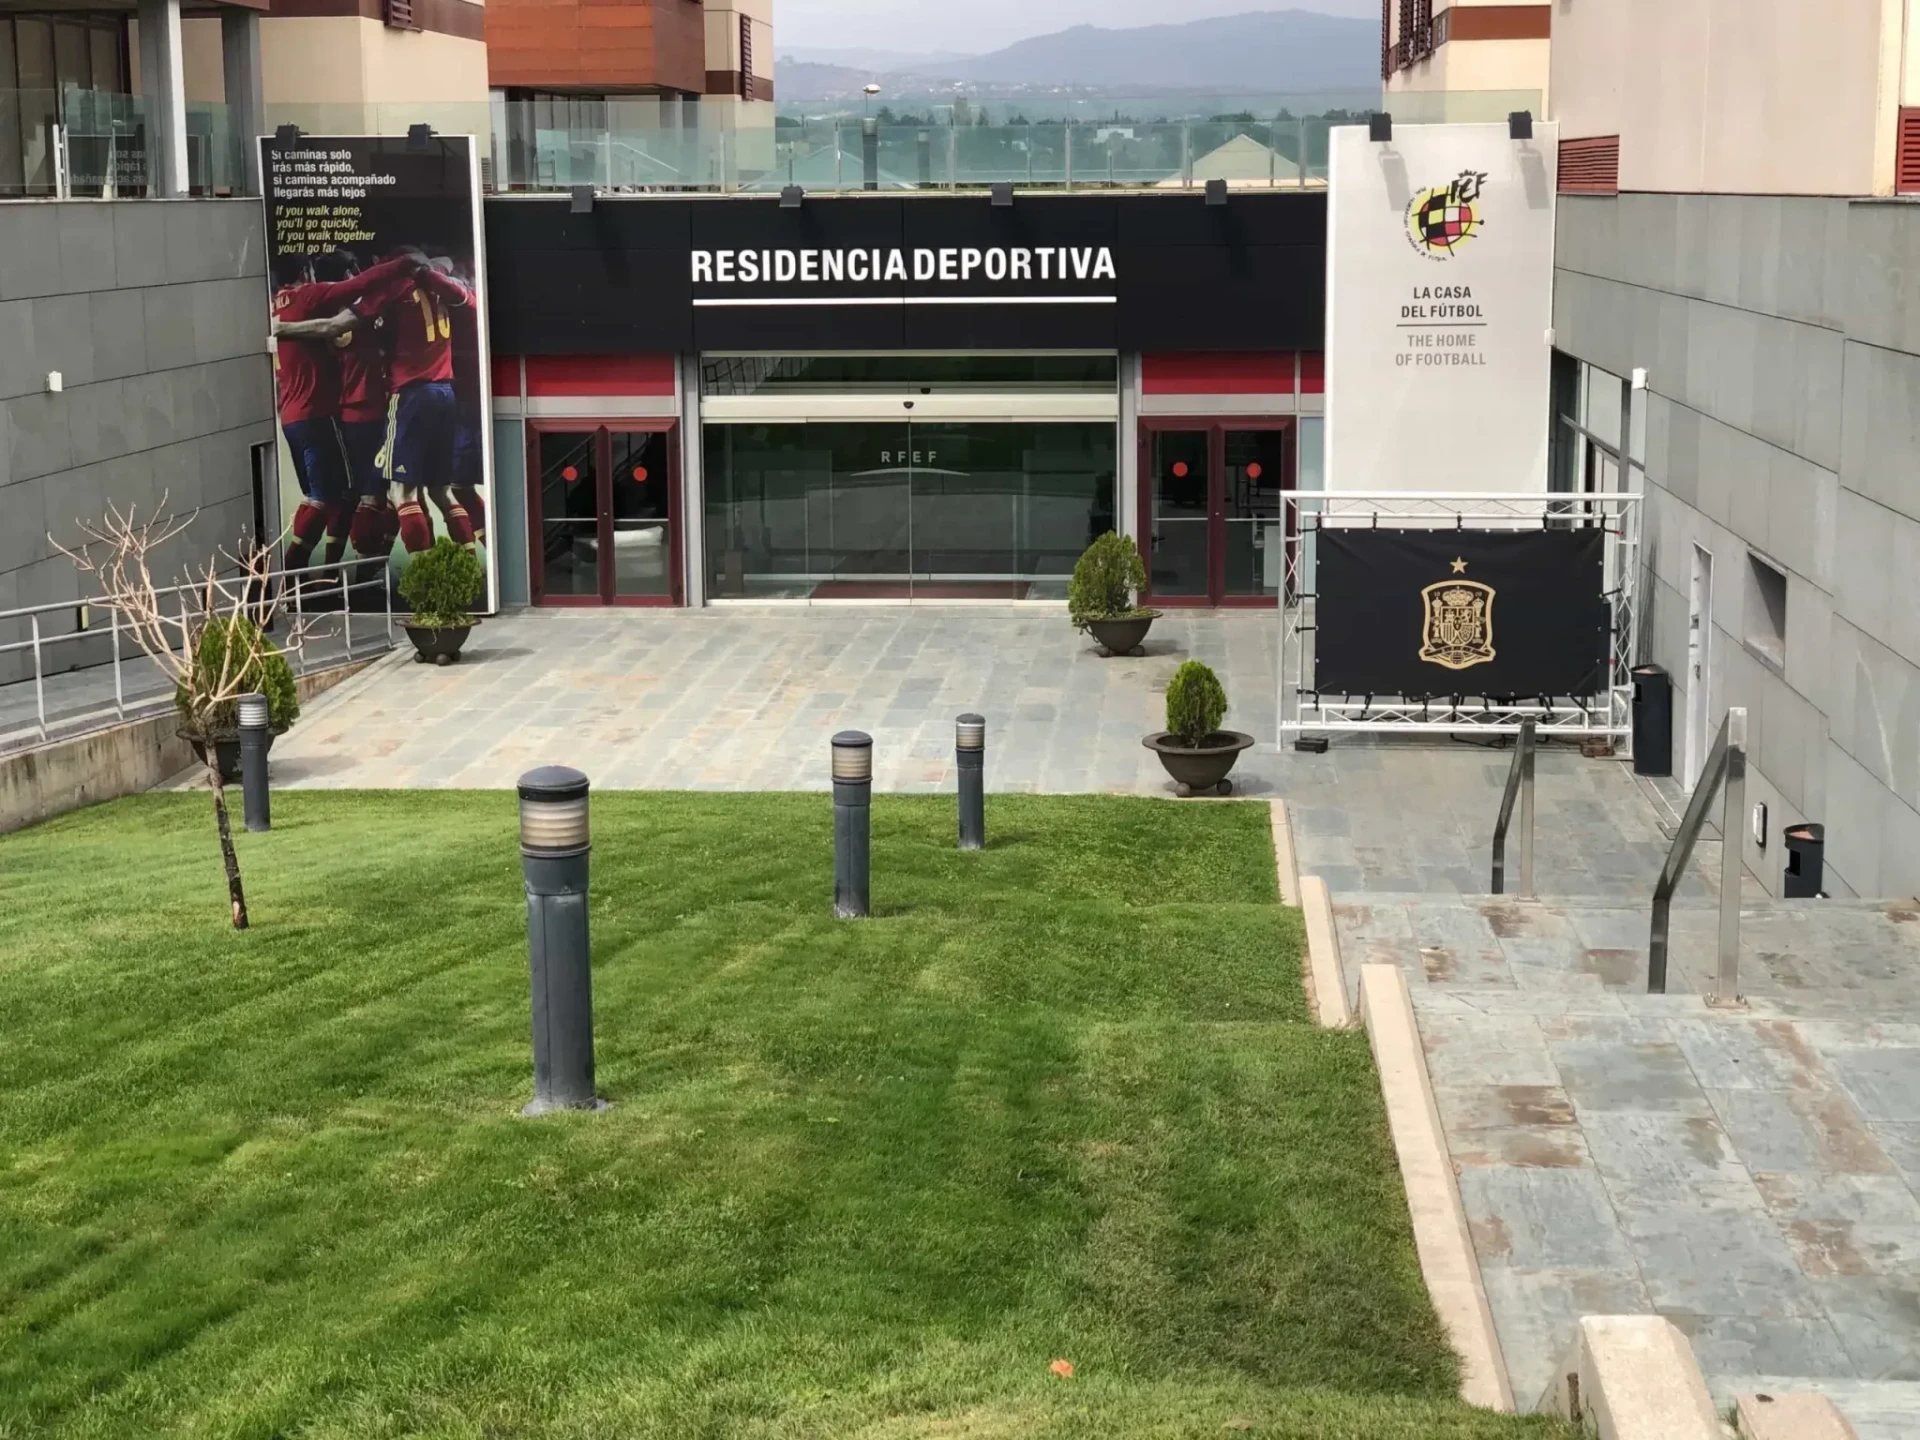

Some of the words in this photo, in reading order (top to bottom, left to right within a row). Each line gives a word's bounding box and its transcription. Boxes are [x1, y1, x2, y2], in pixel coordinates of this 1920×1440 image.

[284, 149, 327, 160] caminas
[330, 149, 352, 160] solo
[272, 161, 292, 172] irás
[294, 161, 316, 172] más
[319, 161, 355, 174] rápido,
[273, 174, 282, 185] si
[285, 174, 328, 185] caminas
[331, 173, 396, 187] acompañado
[274, 186, 314, 199] llegarás
[317, 186, 339, 197] más
[341, 186, 366, 199] lejos
[275, 205, 284, 216] If
[285, 206, 303, 218] you
[306, 205, 330, 216] walk
[332, 205, 362, 217] alone,
[276, 217, 303, 230] you'll
[305, 219, 318, 230] go
[277, 230, 285, 241] if
[286, 231, 305, 243] you
[307, 230, 331, 241] walk
[334, 230, 376, 243] together
[277, 243, 304, 255] you'll
[306, 244, 320, 255] go
[322, 242, 337, 253] far
[691, 249, 909, 282] RESIDENCIA
[913, 247, 1117, 281] DEPORTIVA
[1413, 286, 1431, 299] LA
[1434, 286, 1472, 299] CASA
[412, 288, 451, 342] 10
[1401, 305, 1427, 318] DEL
[1430, 302, 1483, 318] FÚTBOL
[1407, 334, 1433, 347] THE
[1436, 334, 1476, 347] HOME
[1395, 353, 1413, 366] OF
[1416, 352, 1487, 366] FOOTBALL
[881, 450, 937, 463] RFEF
